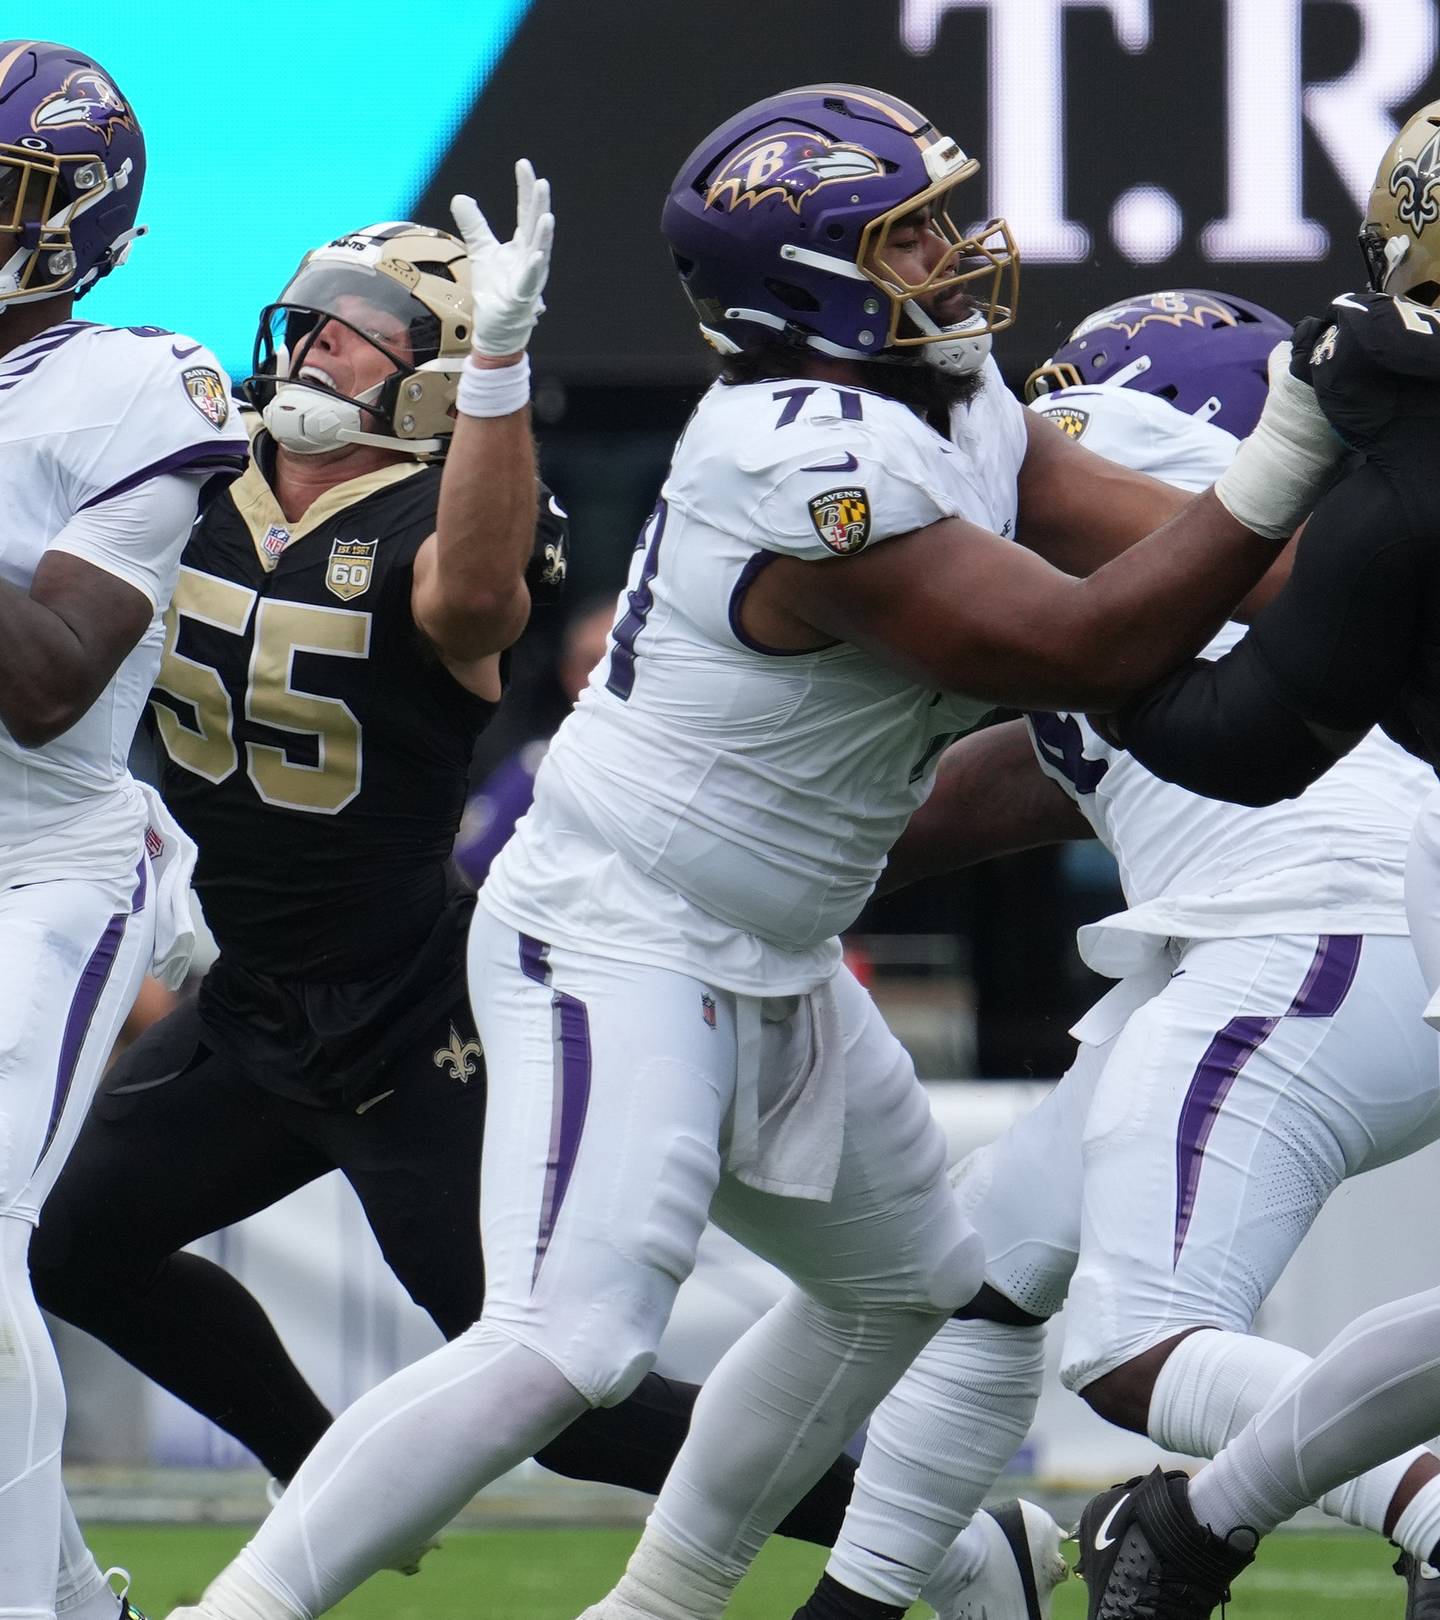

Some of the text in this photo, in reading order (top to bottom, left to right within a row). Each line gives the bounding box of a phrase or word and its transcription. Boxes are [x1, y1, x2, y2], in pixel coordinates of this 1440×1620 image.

[731, 141, 787, 191] B
[183, 368, 219, 380] RAVENS
[772, 386, 863, 430] 71
[811, 490, 862, 508] RAVENS
[331, 563, 368, 587] 60
[150, 564, 372, 816] 55
